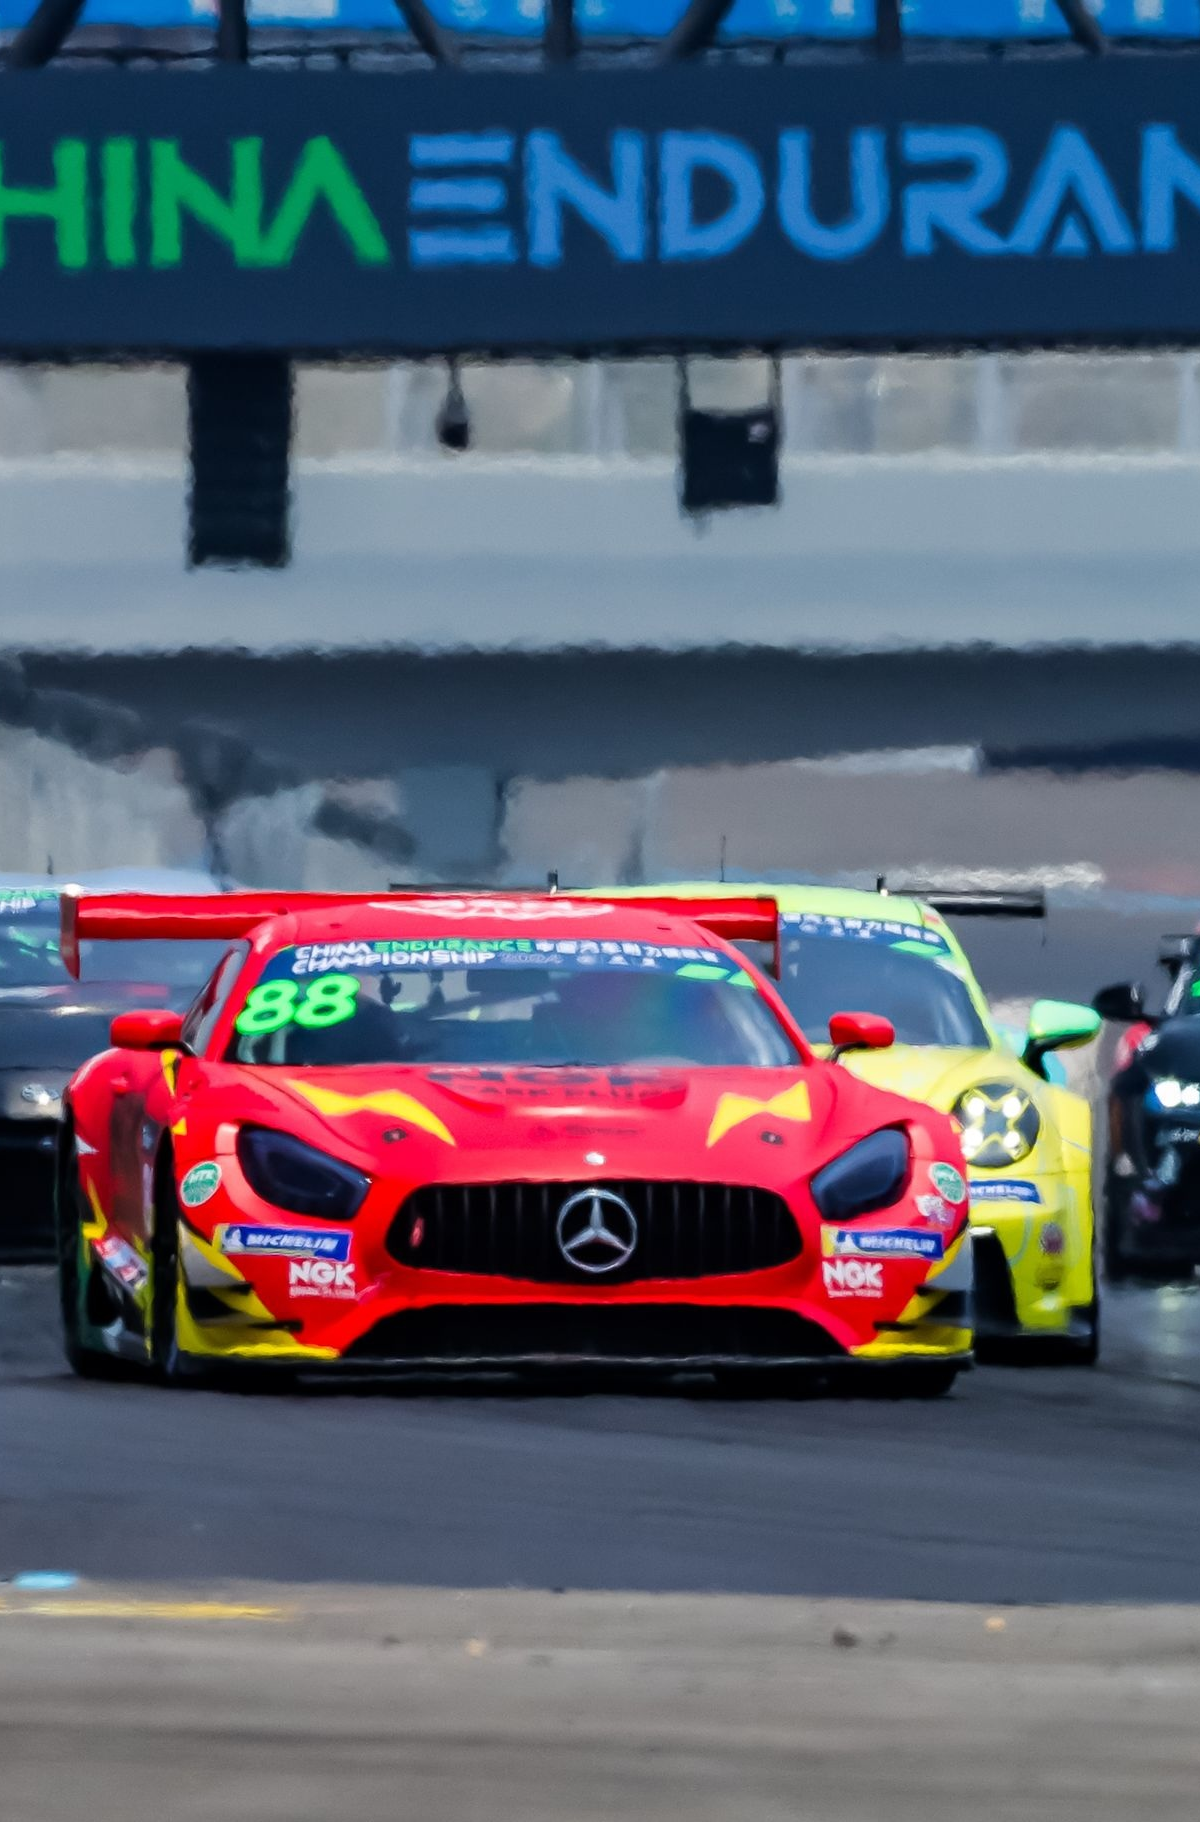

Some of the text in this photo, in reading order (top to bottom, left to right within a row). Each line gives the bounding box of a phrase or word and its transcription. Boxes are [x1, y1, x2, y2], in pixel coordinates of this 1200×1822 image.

[295, 942, 372, 960] CHINA
[373, 939, 531, 953] ENDURANCE
[292, 950, 496, 975] CHAMPIONSHIP
[235, 972, 360, 1035] 88
[246, 1233, 339, 1251] MICHELIN
[289, 1261, 356, 1287] NGK
